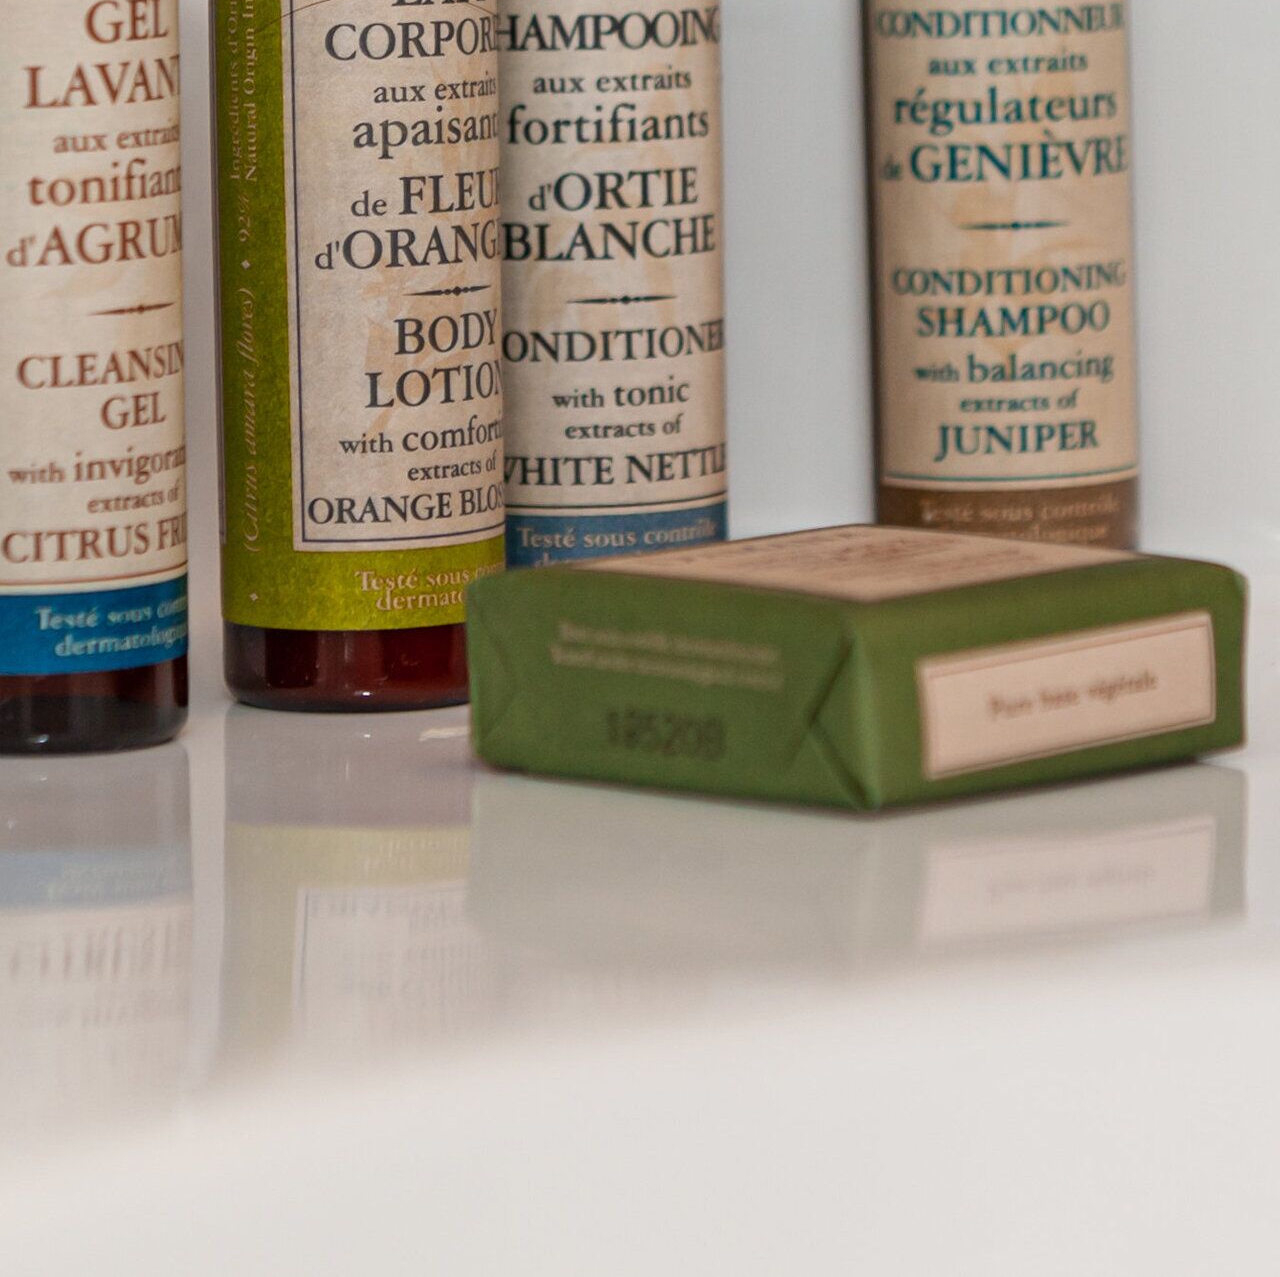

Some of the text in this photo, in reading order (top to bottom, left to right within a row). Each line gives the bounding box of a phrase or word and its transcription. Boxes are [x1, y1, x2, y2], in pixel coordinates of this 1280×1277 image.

[496, 4, 719, 52] HAMPOOIN
[241, 27, 257, 95] Origin
[928, 45, 1088, 76] aux extraits
[373, 71, 496, 104] aux extraits
[532, 64, 692, 95] aux extraits
[507, 102, 710, 145] fortifiants
[894, 85, 1118, 137] régulateurs
[53, 133, 108, 154] aux
[243, 102, 258, 182] Natural
[909, 128, 1129, 183] GENIÈVRE
[350, 190, 388, 217] de
[528, 166, 699, 212] d'ORTIE
[237, 192, 251, 243] 92%
[314, 218, 501, 270] d'ORANG
[501, 213, 717, 262] BLANCHE
[892, 261, 1126, 297] CONDITIONING
[393, 309, 498, 356] BODY
[916, 299, 1111, 338] SHAMPOO
[501, 319, 724, 364] ONDITIONE
[913, 350, 1115, 384] with balancing
[551, 375, 690, 409] with tonic
[959, 388, 1080, 413] extracts of
[100, 391, 168, 430] GEL
[242, 370, 257, 456] amara
[564, 413, 685, 440] extracts of
[339, 433, 394, 455] with
[934, 419, 1099, 463] JUNIPER
[7, 462, 66, 485] with
[407, 450, 497, 481] extracts of
[87, 480, 180, 514] extracts of
[307, 492, 453, 525] ORANGE
[0, 522, 150, 564] CITRUS
[516, 526, 577, 549] Testé
[583, 529, 637, 548] sous
[354, 568, 418, 592] Testé
[426, 570, 469, 586] sous
[35, 606, 99, 631] Testé
